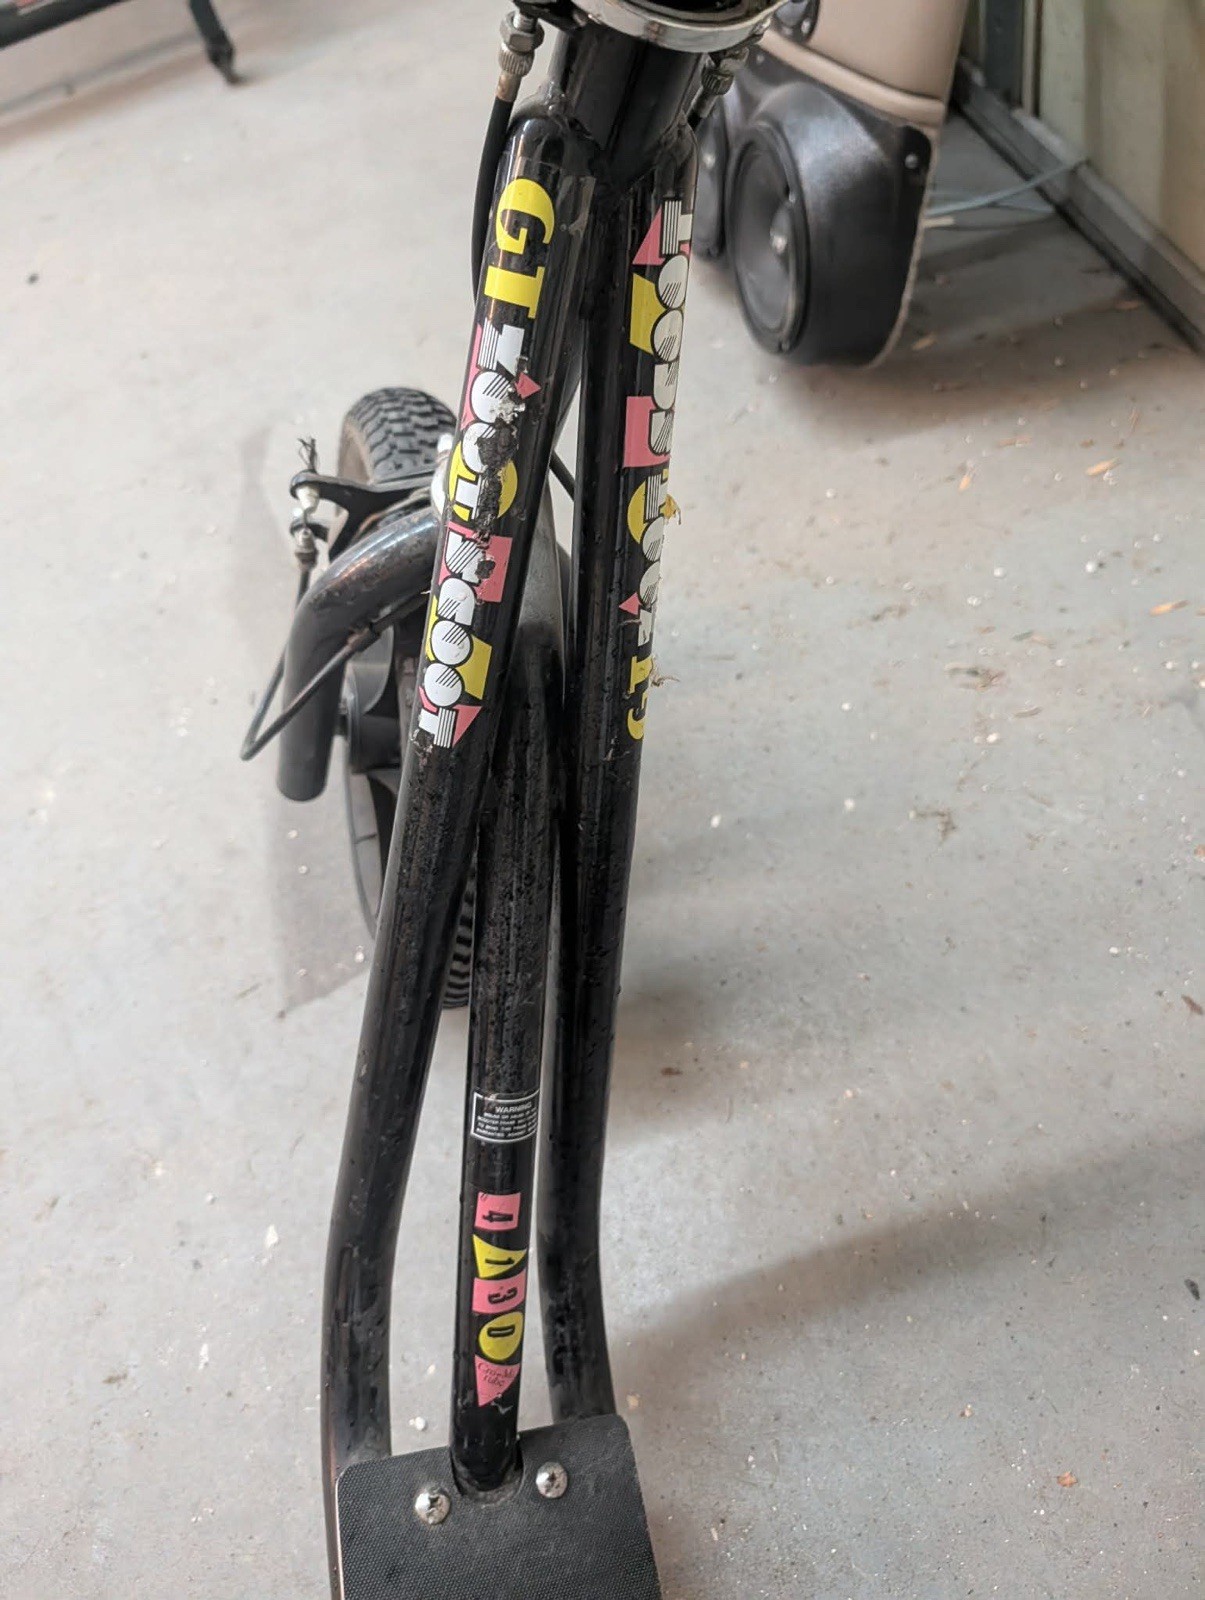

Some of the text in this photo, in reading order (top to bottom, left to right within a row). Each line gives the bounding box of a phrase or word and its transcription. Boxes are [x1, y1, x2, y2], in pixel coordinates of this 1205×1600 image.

[484, 178, 554, 320] GT
[648, 199, 692, 455] SCOOT
[418, 529, 484, 748] SCOOT
[495, 1101, 532, 1113] WARNING
